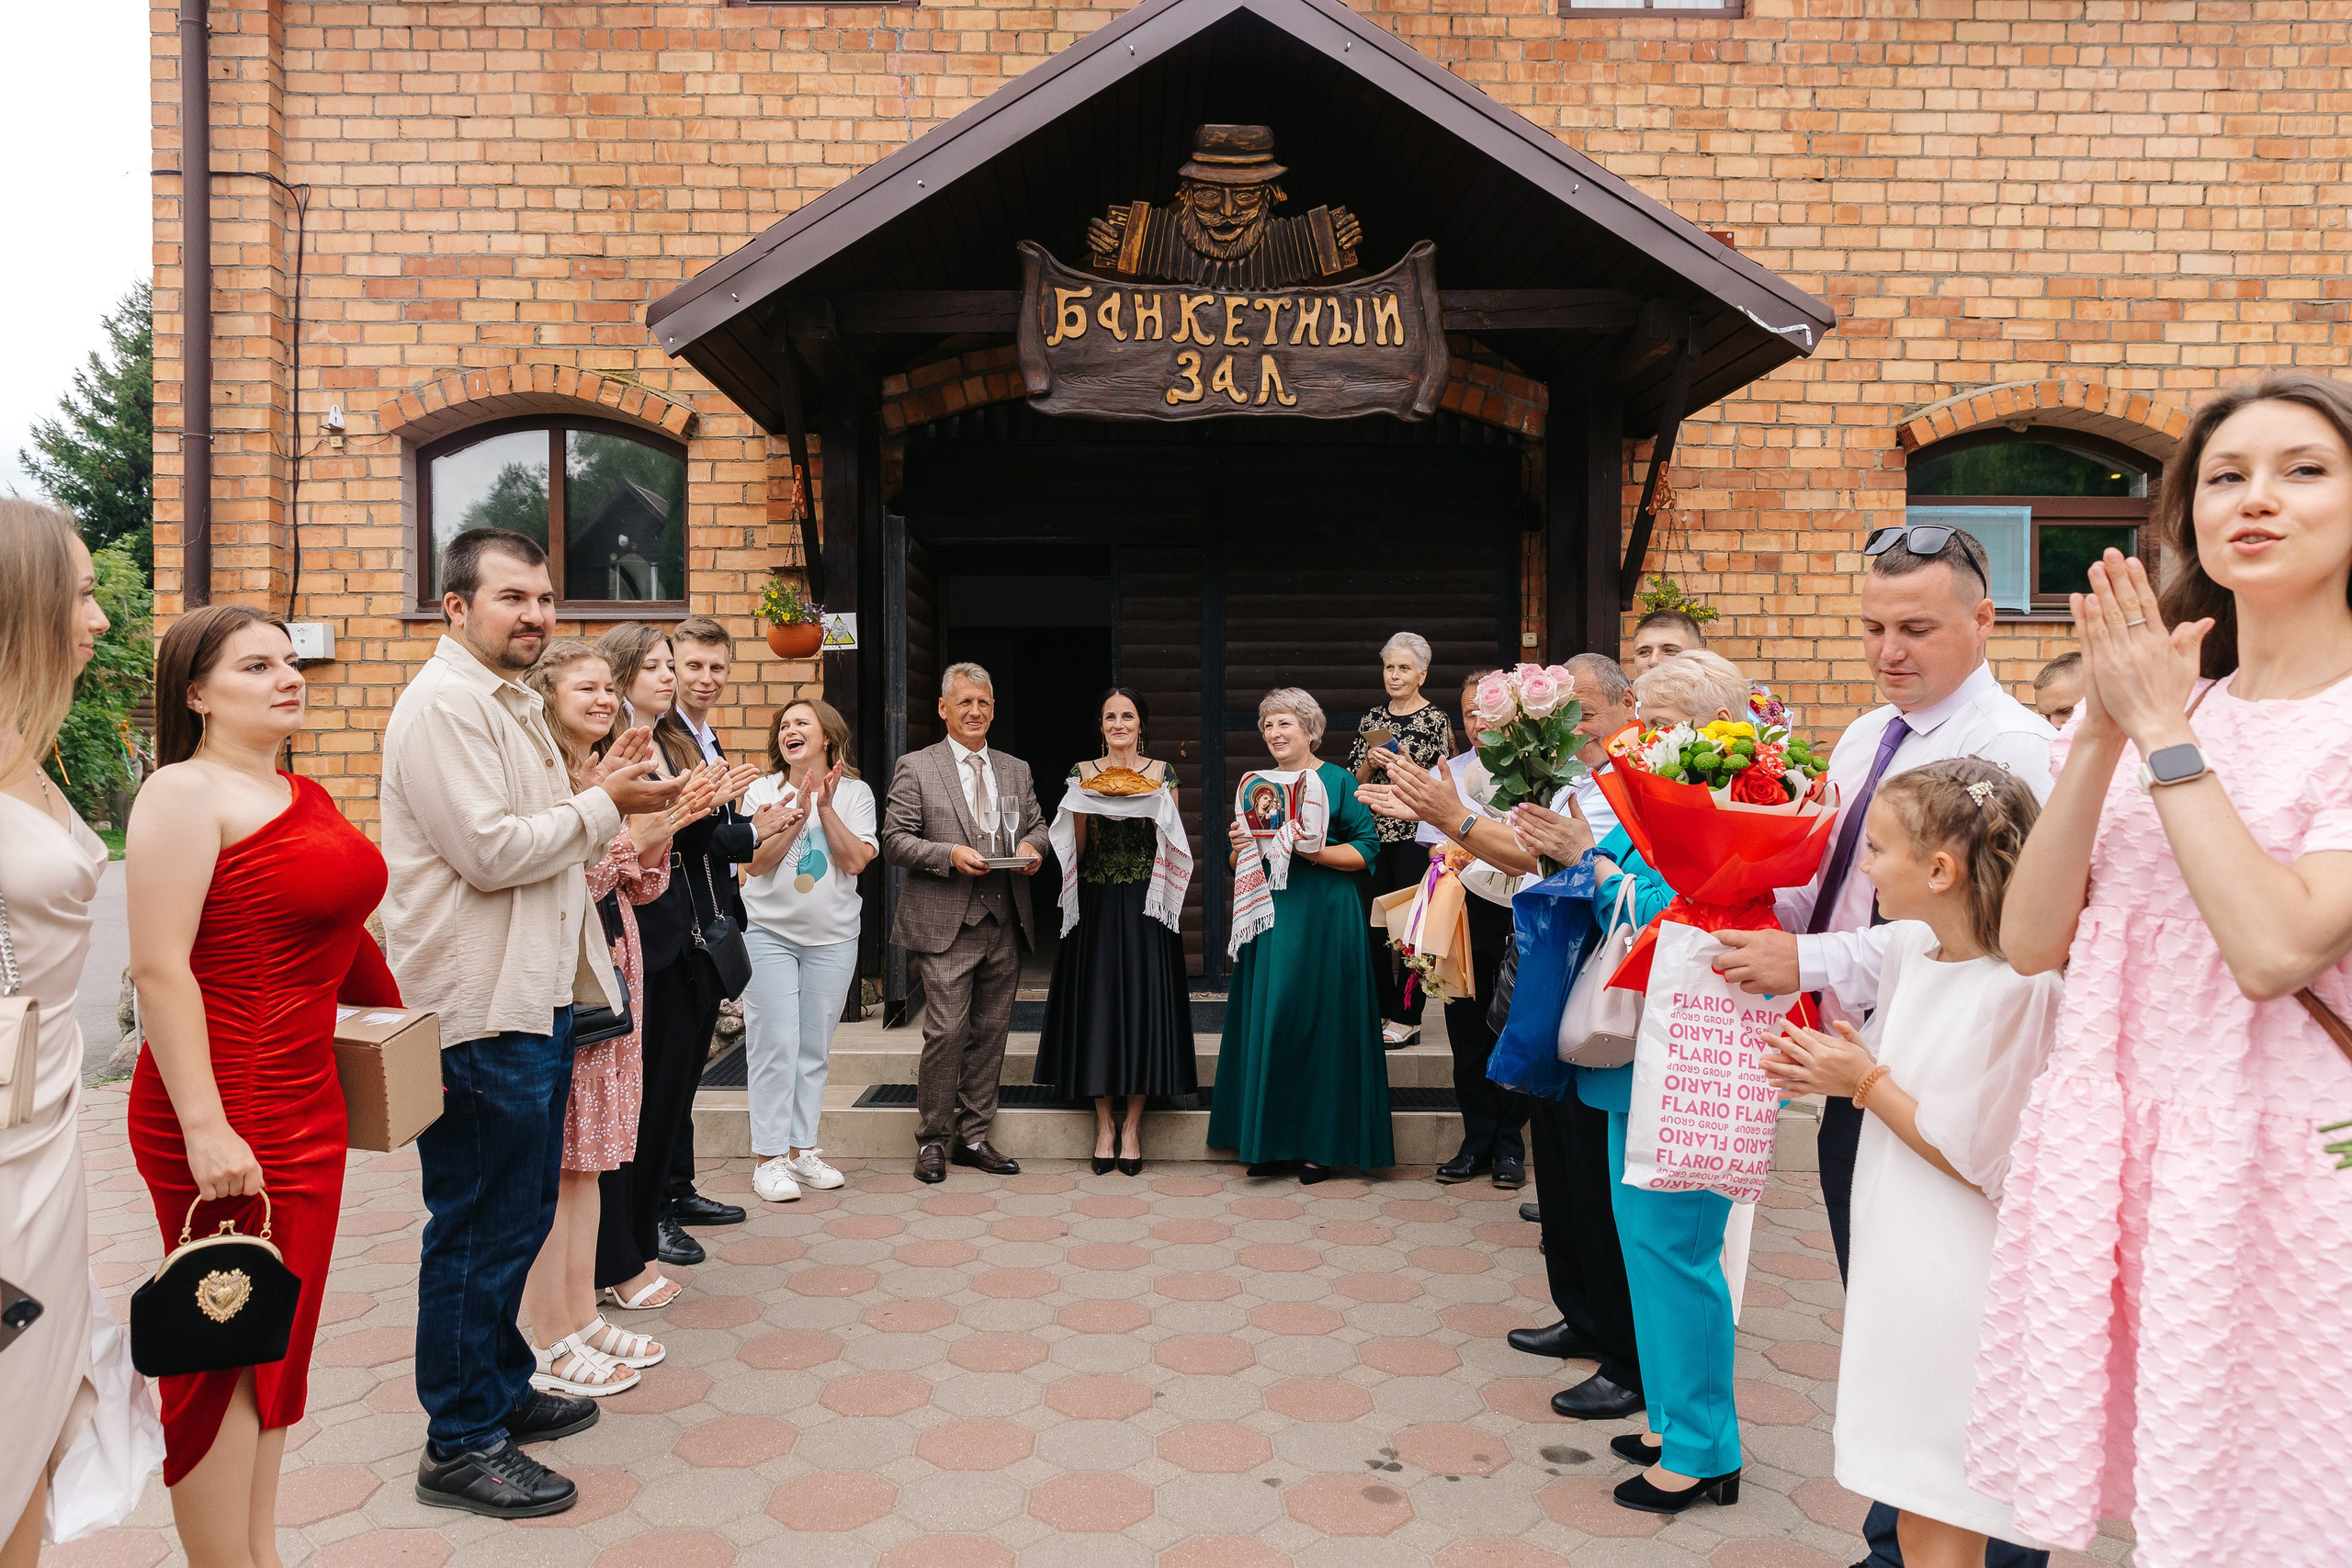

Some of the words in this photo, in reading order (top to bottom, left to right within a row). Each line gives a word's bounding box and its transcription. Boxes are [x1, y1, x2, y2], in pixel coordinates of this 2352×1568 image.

[1166, 351, 1297, 406] ЗАЛ
[1673, 993, 1735, 1013] FLARIO
[1670, 1010, 1701, 1021] GROUP
[1703, 1015, 1735, 1026] GROUP
[1669, 1022, 1734, 1045] FLARIO
[1668, 1043, 1733, 1066] FLARIO
[1667, 1063, 1700, 1074] GROUP
[1702, 1067, 1732, 1078] GROUP
[1664, 1075, 1731, 1098] FLARIO
[1661, 1095, 1730, 1119] FLARIO
[1660, 1115, 1695, 1127] GROUP
[1698, 1120, 1729, 1132] GROUP
[1658, 1127, 1728, 1151] FLARIO
[1656, 1148, 1724, 1171] FLARIO
[1689, 1171, 1720, 1181] GROUP
